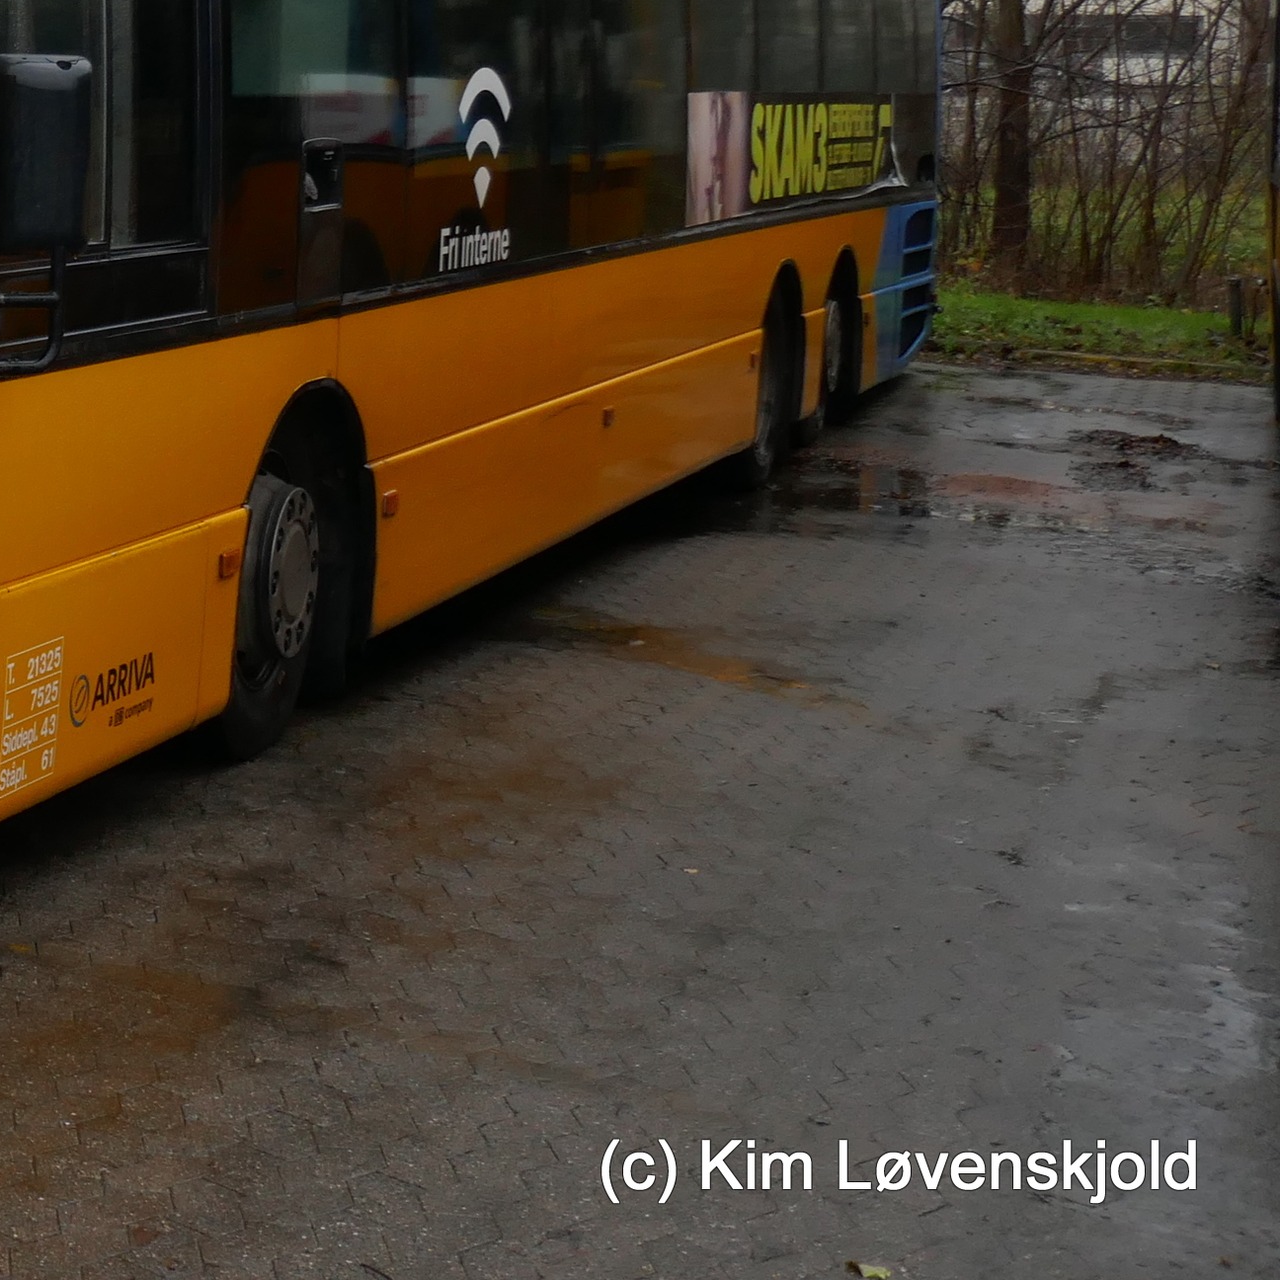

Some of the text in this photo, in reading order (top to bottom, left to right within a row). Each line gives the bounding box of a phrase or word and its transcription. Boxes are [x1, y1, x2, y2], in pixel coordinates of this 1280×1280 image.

[439, 225, 509, 272] Fri interne
[6, 646, 62, 685] T. 21325
[91, 652, 155, 711] ARRIVA
[5, 680, 59, 720] L. 7525
[125, 697, 154, 719] company
[2, 714, 57, 756] Siddepl. 43
[0, 748, 54, 791] Ståpl. 61
